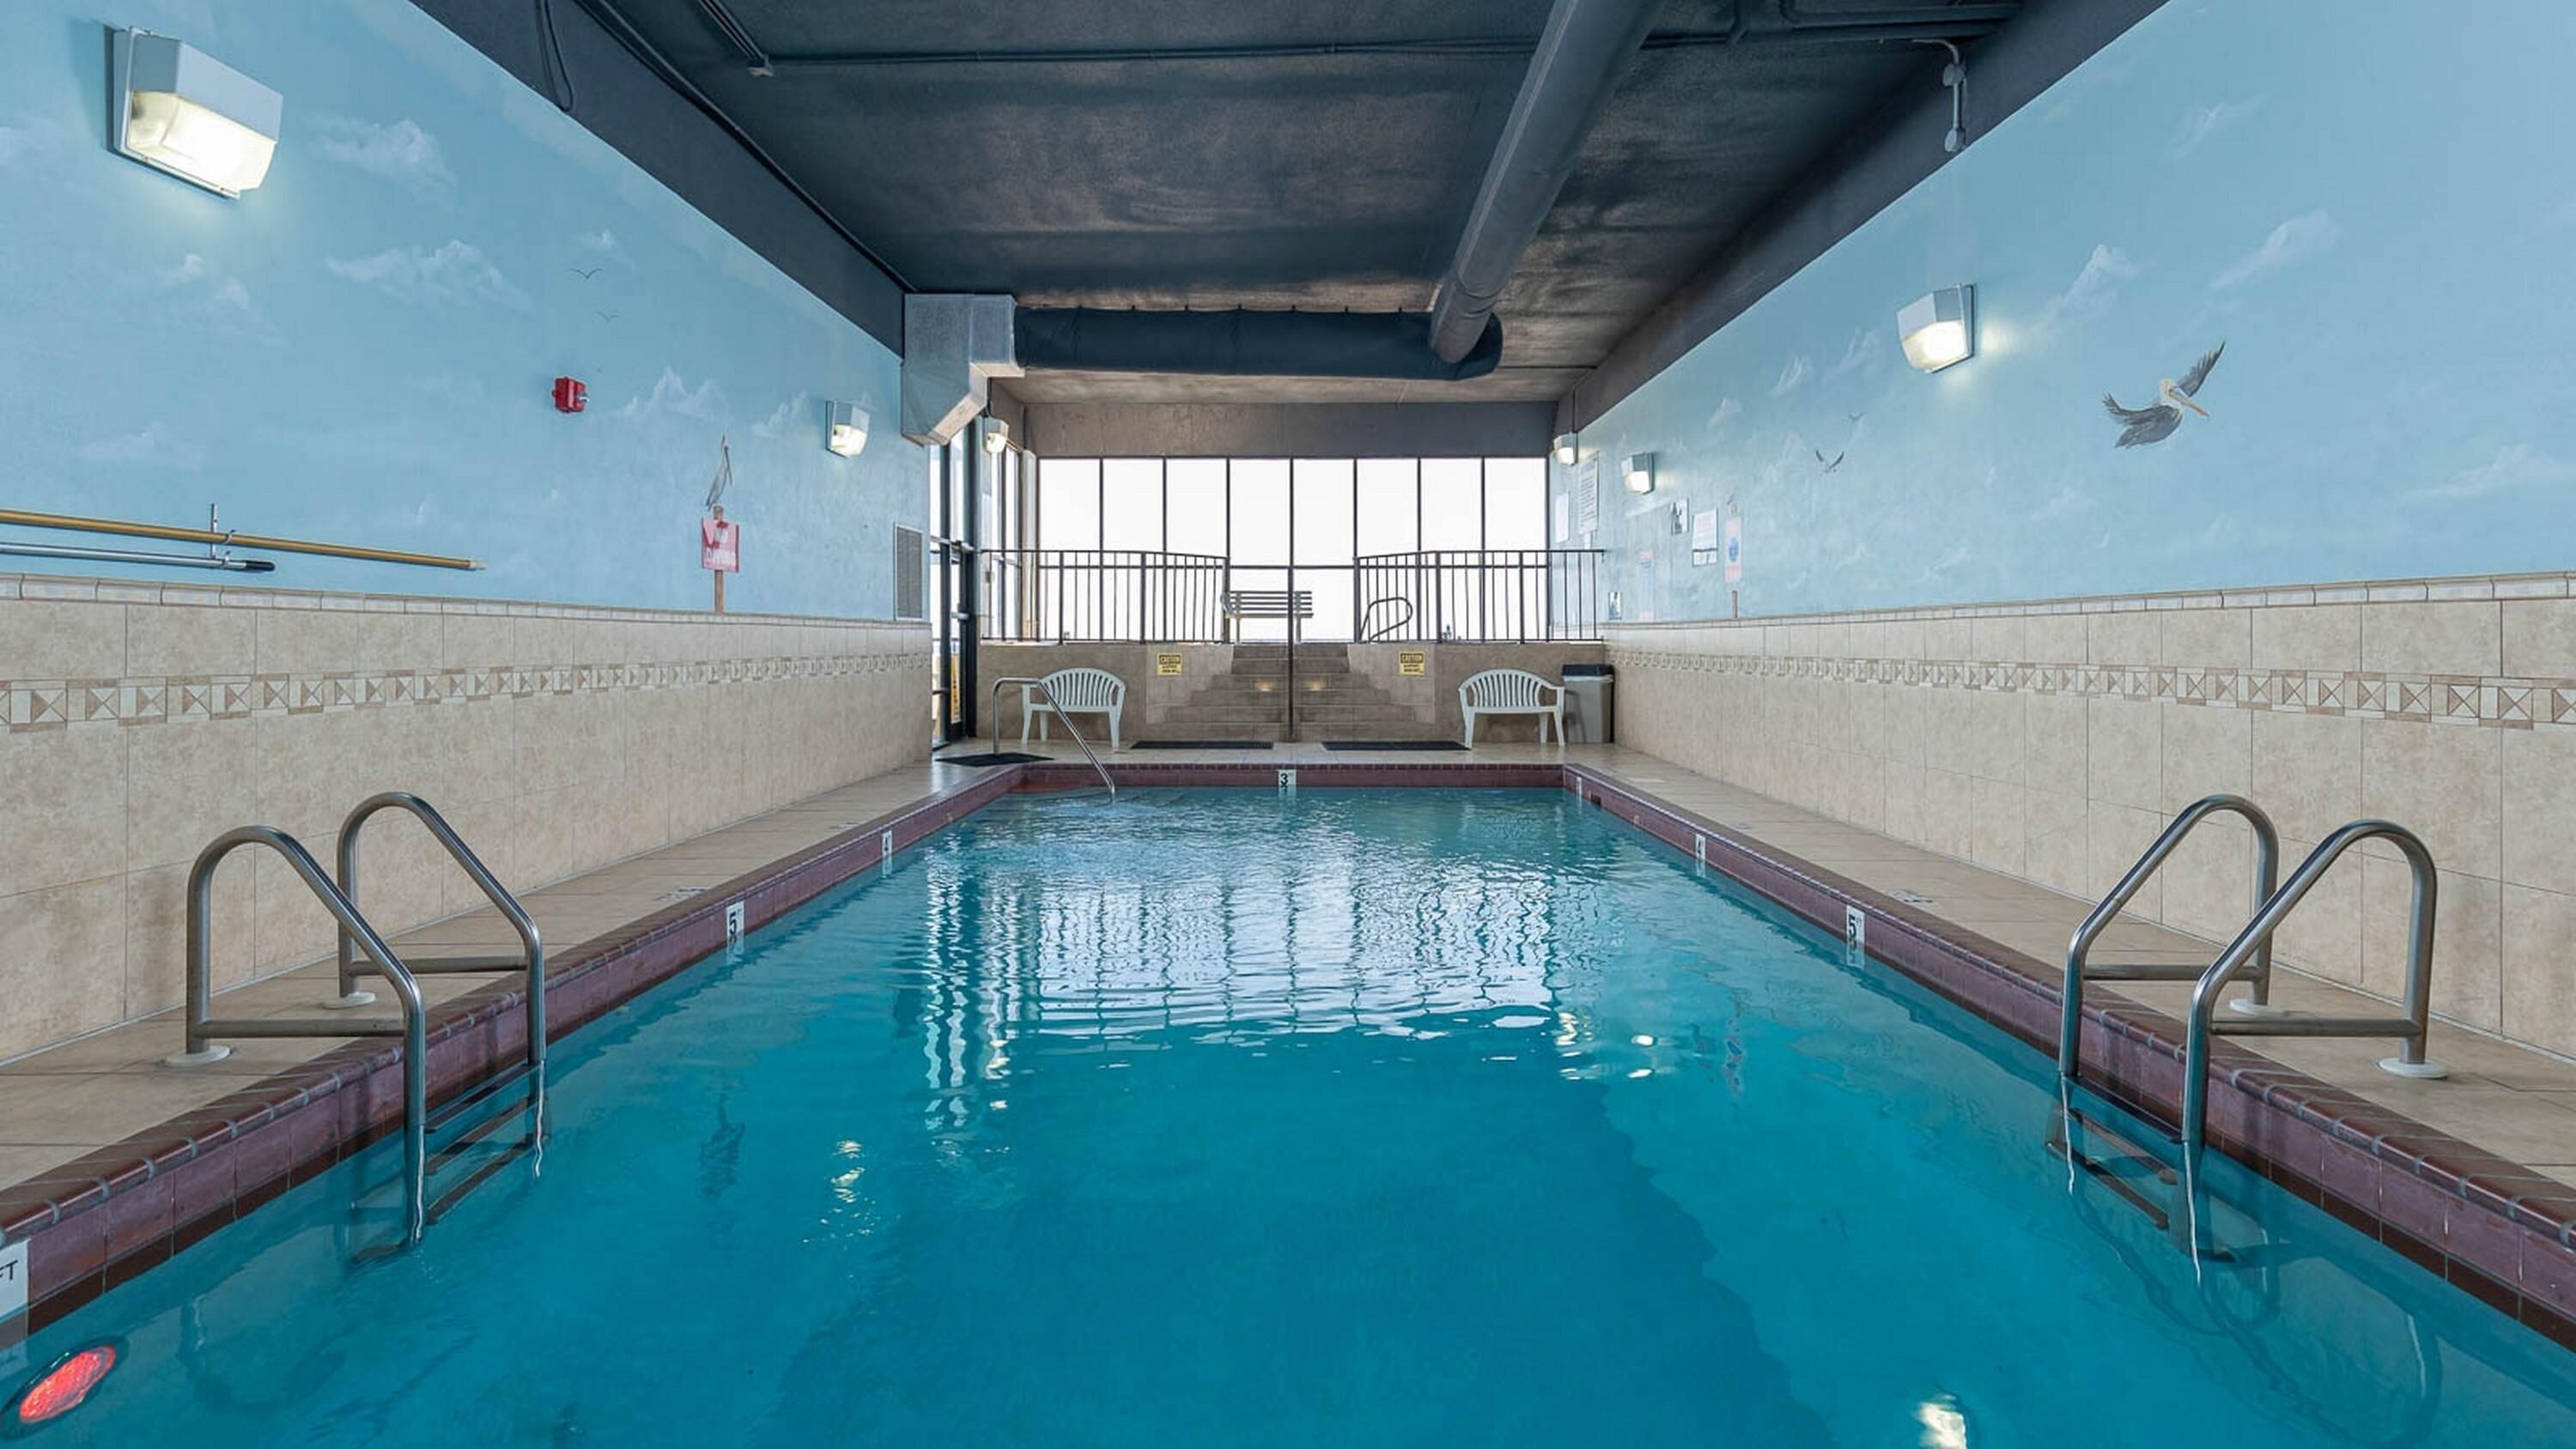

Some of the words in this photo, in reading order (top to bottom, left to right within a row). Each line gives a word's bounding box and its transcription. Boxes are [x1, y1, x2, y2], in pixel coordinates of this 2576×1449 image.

[1280, 773, 1289, 785] 3
[729, 910, 737, 935] 5
[1849, 913, 1856, 937] 5
